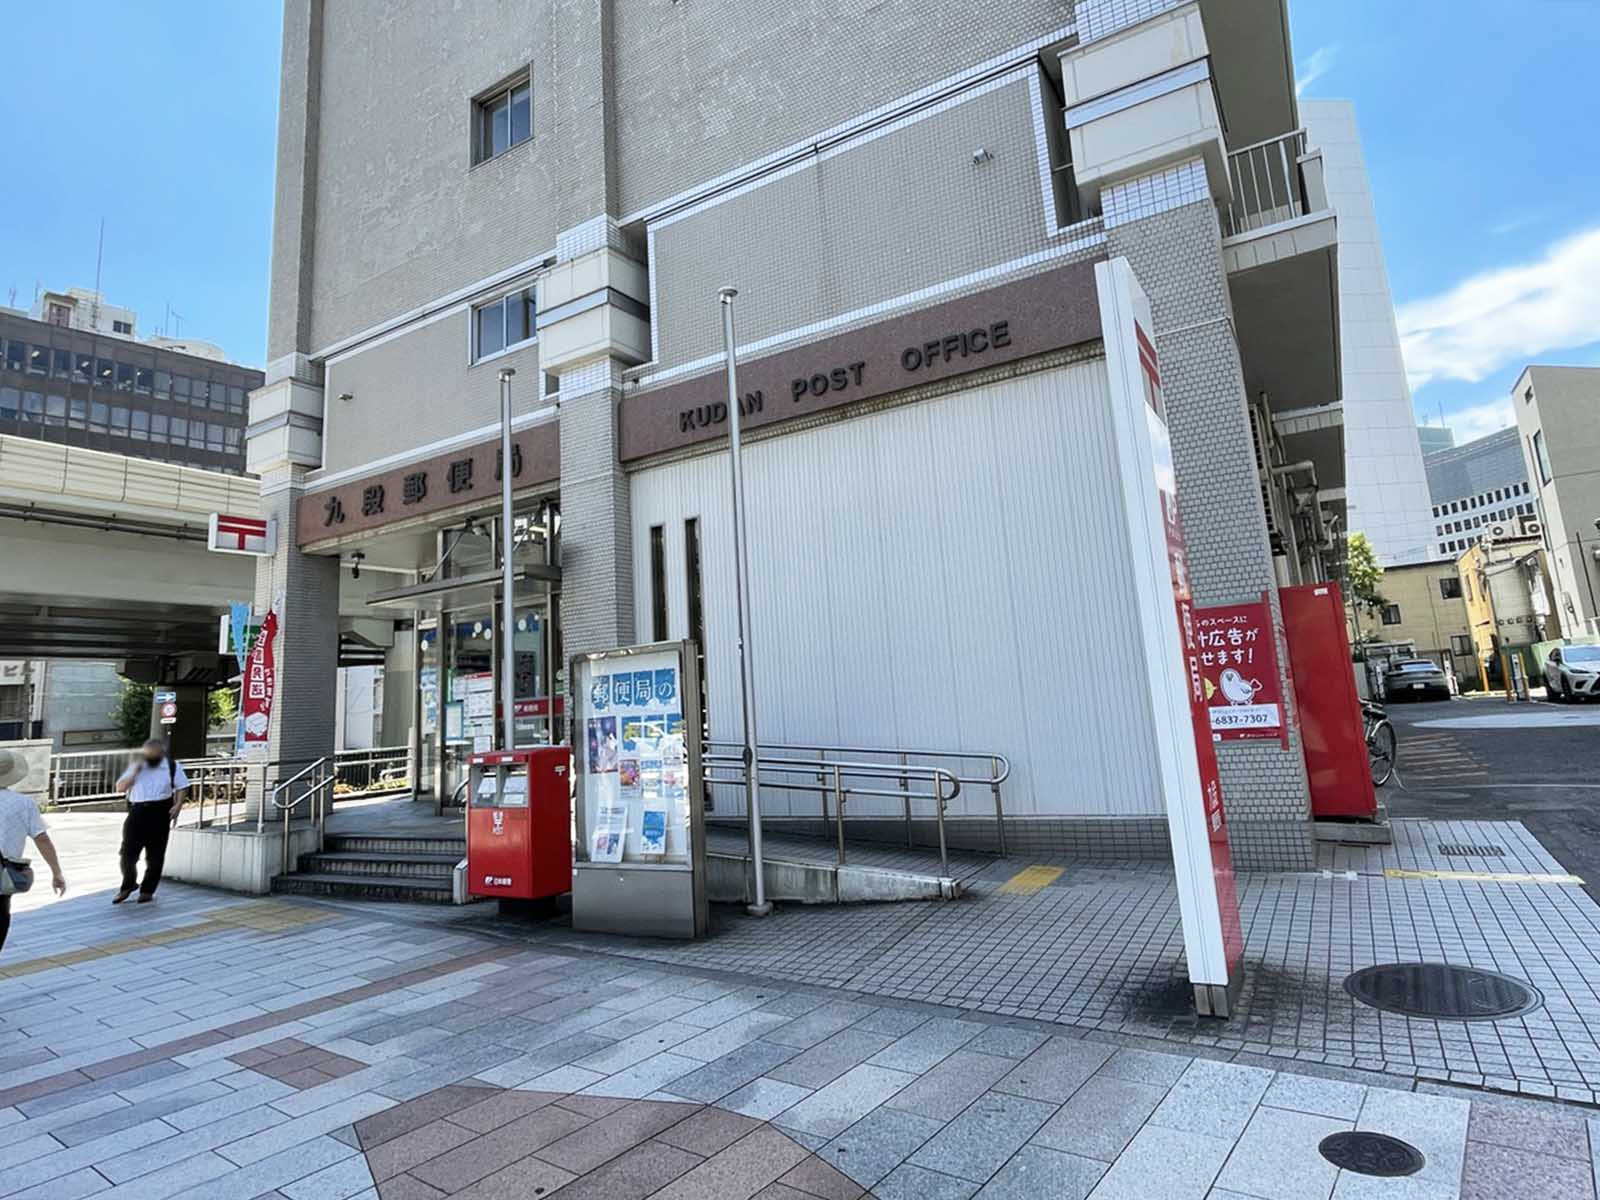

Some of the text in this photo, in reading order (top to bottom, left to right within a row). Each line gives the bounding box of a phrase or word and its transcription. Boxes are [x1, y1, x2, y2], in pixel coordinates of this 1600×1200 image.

[791, 361, 865, 402] POST
[901, 320, 1012, 371] OFFICE
[592, 679, 673, 704] 郵便局の
